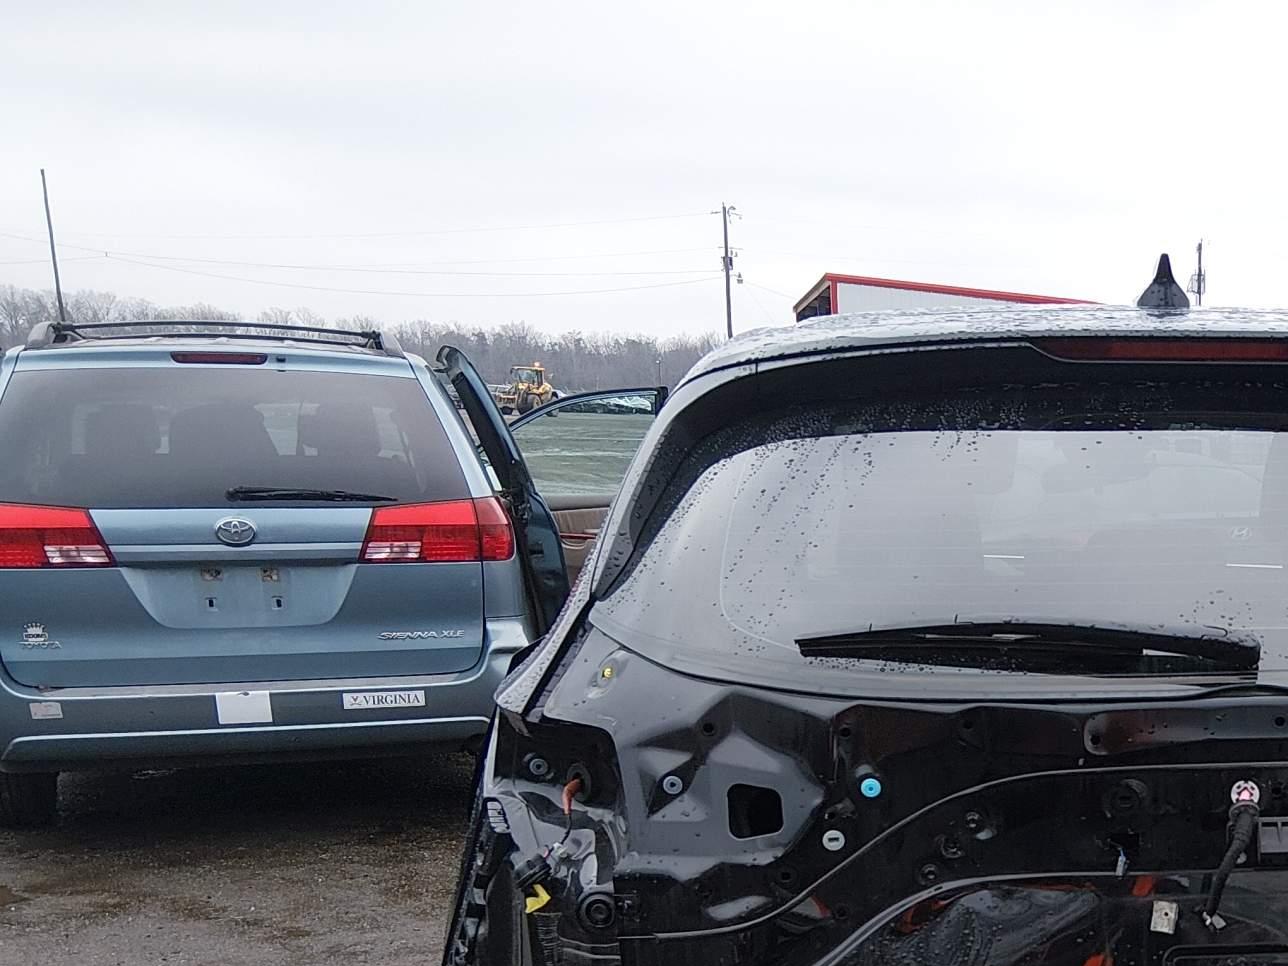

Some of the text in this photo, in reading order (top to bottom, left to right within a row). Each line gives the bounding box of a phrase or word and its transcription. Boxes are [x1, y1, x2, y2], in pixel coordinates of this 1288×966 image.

[378, 629, 465, 641] SIENNA XLE
[362, 693, 421, 706] VIRGINIA
